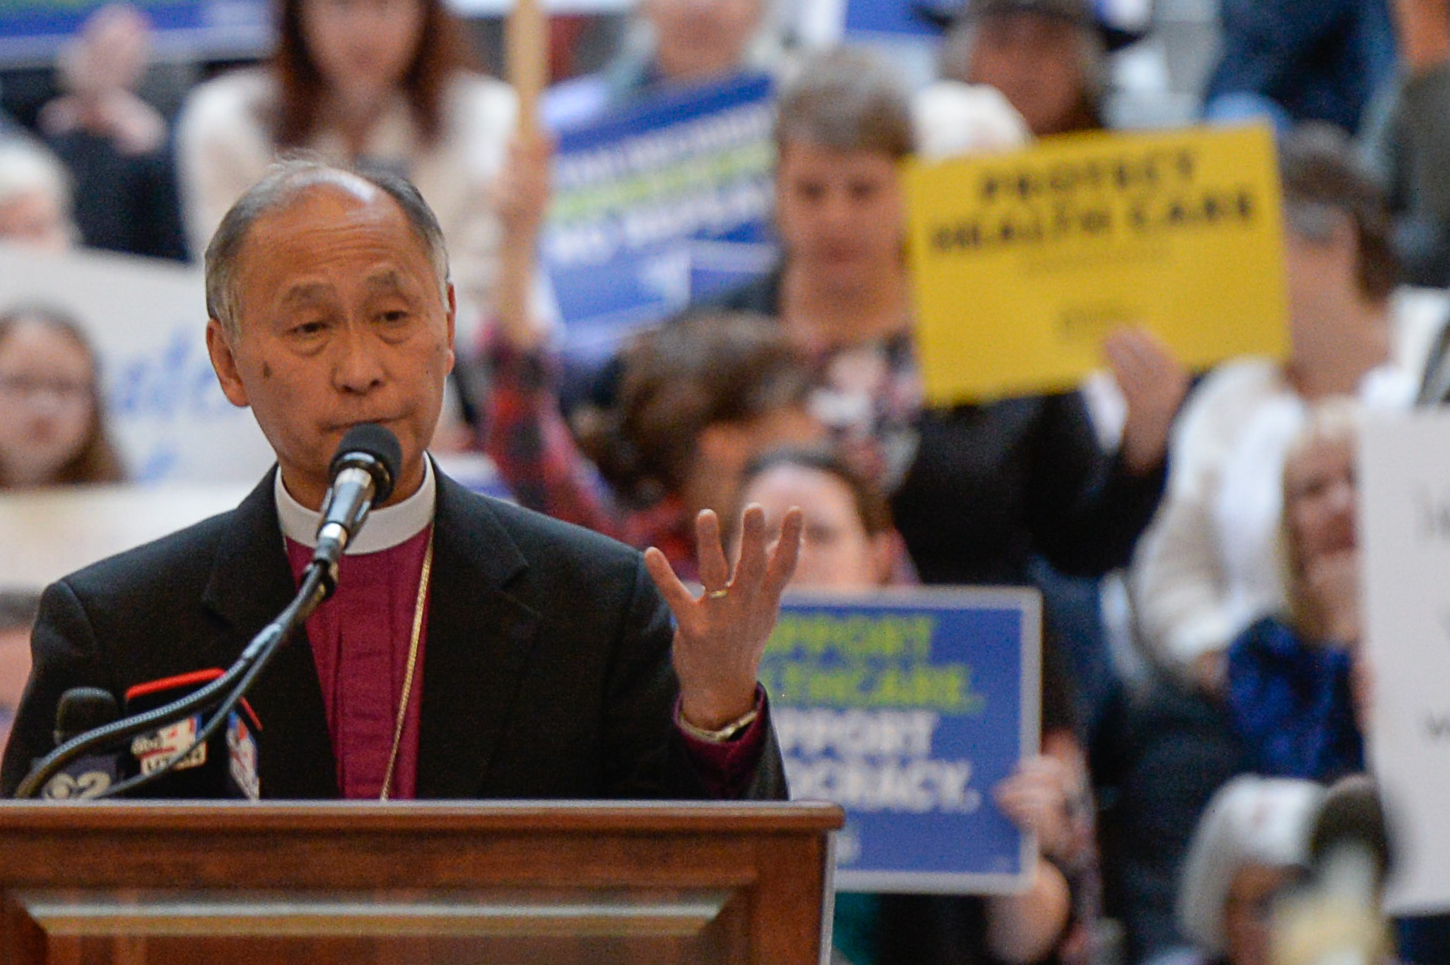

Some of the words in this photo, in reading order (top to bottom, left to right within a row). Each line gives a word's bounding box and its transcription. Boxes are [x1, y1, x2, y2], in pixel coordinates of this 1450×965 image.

[980, 149, 1193, 200] PROTECT
[929, 200, 1111, 252] HEALTH
[1126, 188, 1255, 228] CARE
